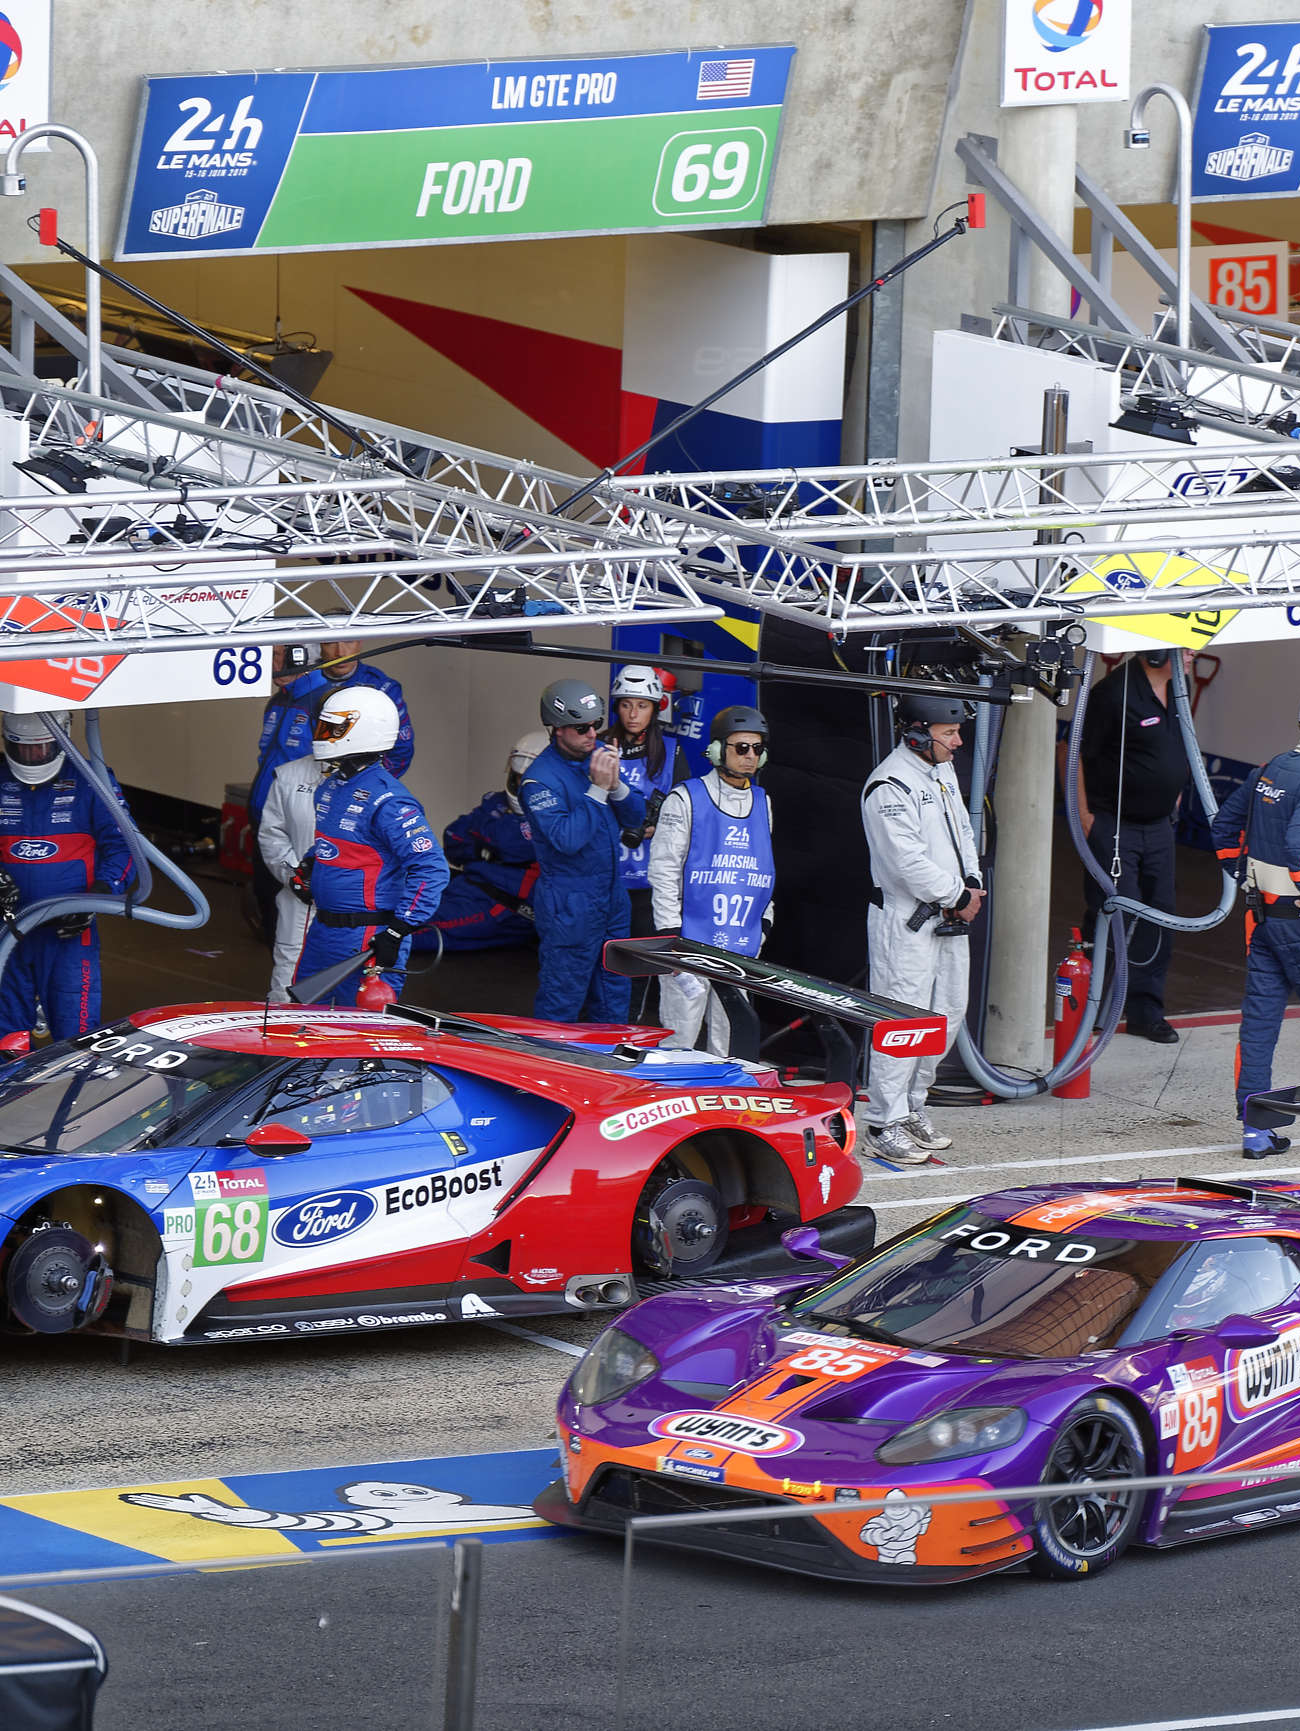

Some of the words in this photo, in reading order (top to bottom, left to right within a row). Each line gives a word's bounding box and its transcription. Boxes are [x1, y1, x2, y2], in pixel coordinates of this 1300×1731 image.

[491, 75, 527, 110] LM
[529, 73, 573, 109] GTE
[573, 71, 618, 107] PRO
[1014, 66, 1118, 92] TOTAL
[1213, 97, 1243, 113] LE
[163, 95, 263, 152] 24h
[156, 154, 187, 170] LE
[187, 152, 254, 169] MANS
[670, 140, 750, 203] 69
[1205, 145, 1293, 179] SUPERFINALE
[415, 157, 533, 218] FORD
[150, 202, 243, 237] SUPERFINALE
[1216, 260, 1271, 311] 85
[160, 589, 249, 604] PERFORMANCE
[212, 646, 263, 686] 68
[725, 825, 751, 842] 24h
[18, 840, 50, 858] Ford
[711, 853, 759, 871] MARSHAL
[689, 869, 738, 886] PITLANE
[712, 893, 755, 927] 927
[774, 978, 846, 1005] Powered
[845, 997, 861, 1009] by
[165, 1017, 225, 1034] FORD
[881, 1027, 942, 1047] GT
[77, 1027, 189, 1069] FORD
[470, 1116, 497, 1126] GT
[626, 1101, 690, 1130] Castrol
[695, 1094, 800, 1114] EDGE
[219, 1178, 264, 1190] TOTAL
[385, 1160, 503, 1216] EcoBoost
[166, 1214, 194, 1235] PRO
[203, 1201, 261, 1262] 68
[292, 1198, 356, 1242] Ford
[940, 1223, 1098, 1264] FORD
[204, 1322, 288, 1340] sparco
[378, 1311, 447, 1329] brembo
[788, 1348, 879, 1377] 85
[855, 1343, 900, 1357] TOTAL
[1181, 1386, 1219, 1453] 85
[675, 1464, 720, 1478] MICHELIN
